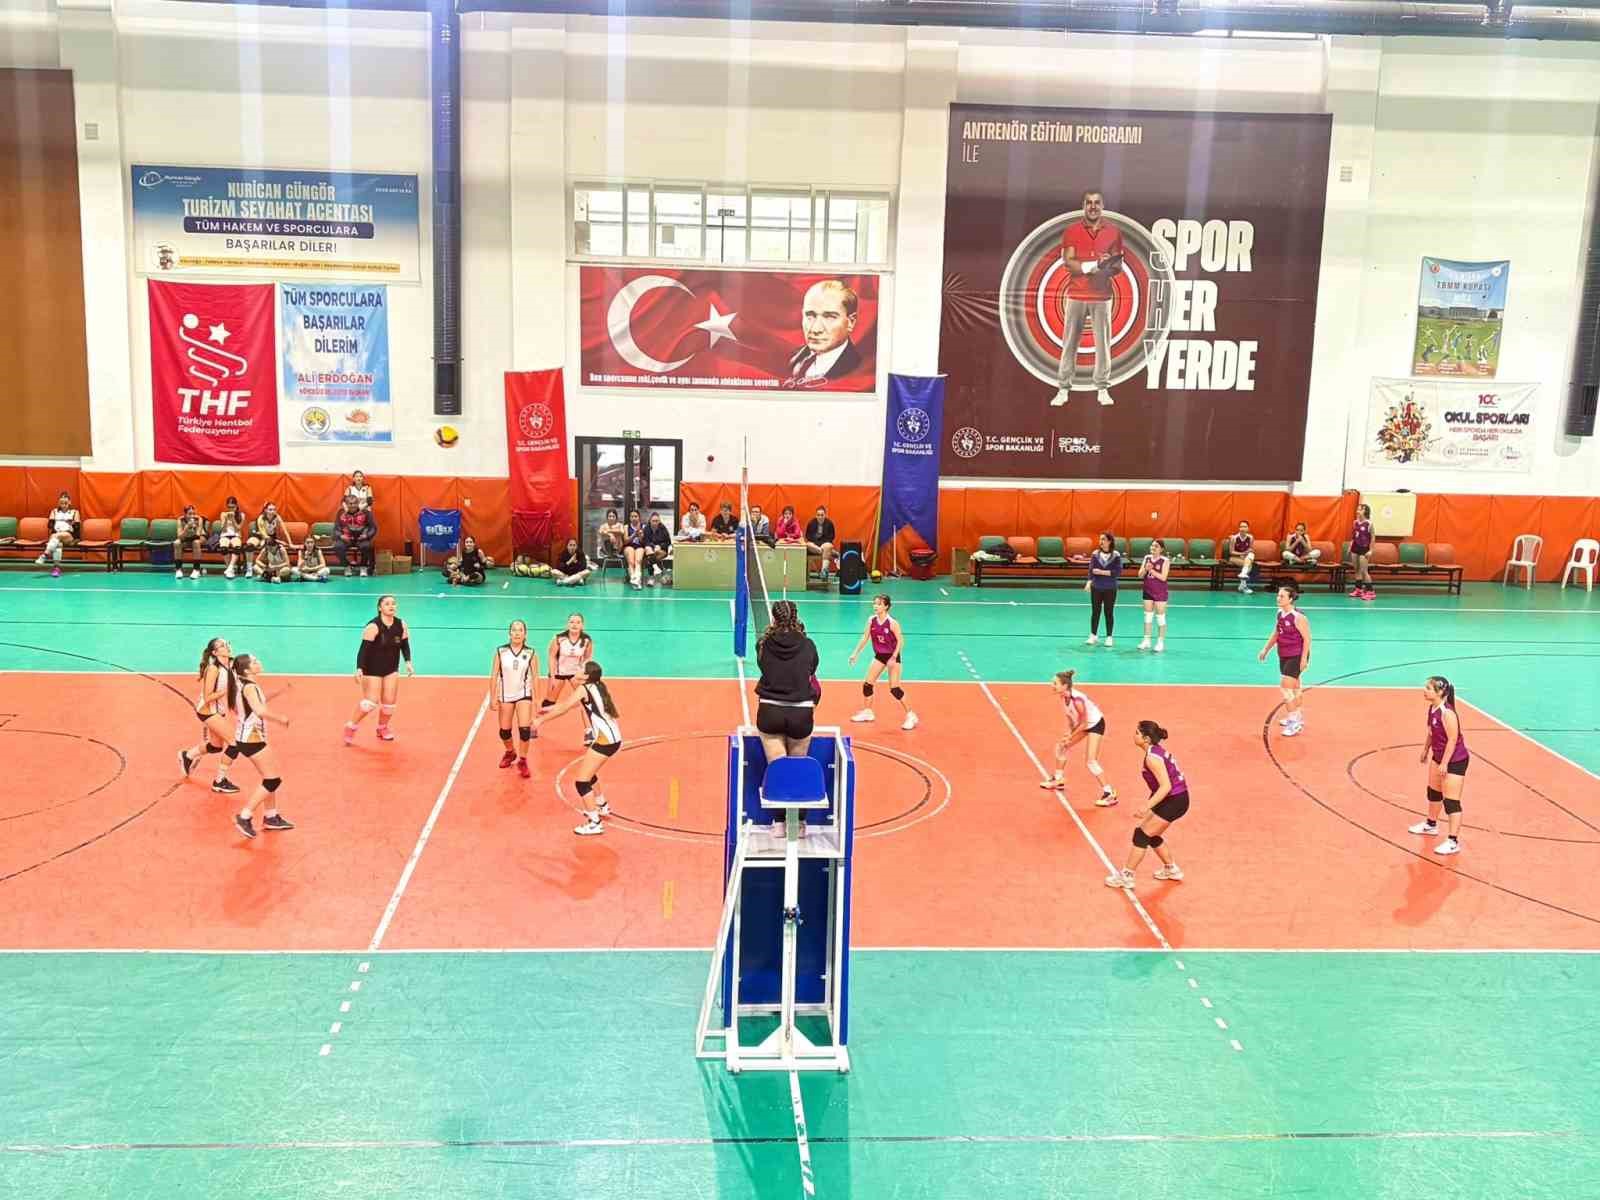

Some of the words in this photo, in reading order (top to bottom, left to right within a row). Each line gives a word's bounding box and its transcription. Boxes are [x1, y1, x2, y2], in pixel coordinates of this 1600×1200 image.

[963, 120, 1027, 142] ANTRENÖR
[1031, 121, 1073, 143] EĞİTİM
[1076, 125, 1142, 144] PROGRAMI
[962, 143, 979, 163] İLE
[228, 180, 281, 200] NURİCAN
[285, 182, 335, 201] GÜNGÖR
[183, 196, 236, 218] TURİZM
[240, 200, 302, 220] SEYAHAT
[307, 203, 374, 223] ACENTASI
[196, 220, 220, 232] TÜM
[223, 222, 263, 233] HAKEM
[267, 224, 280, 233] VE
[284, 224, 359, 236] SPORCULARA
[226, 239, 296, 252] BAŞARILAR
[300, 240, 337, 254] DİLER!
[1149, 218, 1255, 272] SPOR
[284, 288, 307, 305] TÜM
[310, 291, 383, 308] SPORCULARA
[1145, 279, 1219, 332] HER
[304, 316, 365, 332] BAŞARILAR
[315, 336, 358, 354] DİLERİM
[1143, 339, 1258, 391] YERDE
[318, 372, 373, 383] ERDOĞAN
[178, 388, 252, 416] THF
[178, 416, 213, 427] Türkiye
[214, 418, 253, 427] Hentbol
[1444, 411, 1474, 424] OKUL
[1476, 412, 1530, 425] SPORLARI
[178, 425, 240, 436] Federasyonu
[1000, 436, 1032, 444] GENÇLİK
[1006, 444, 1044, 452] BAKANLIĞI
